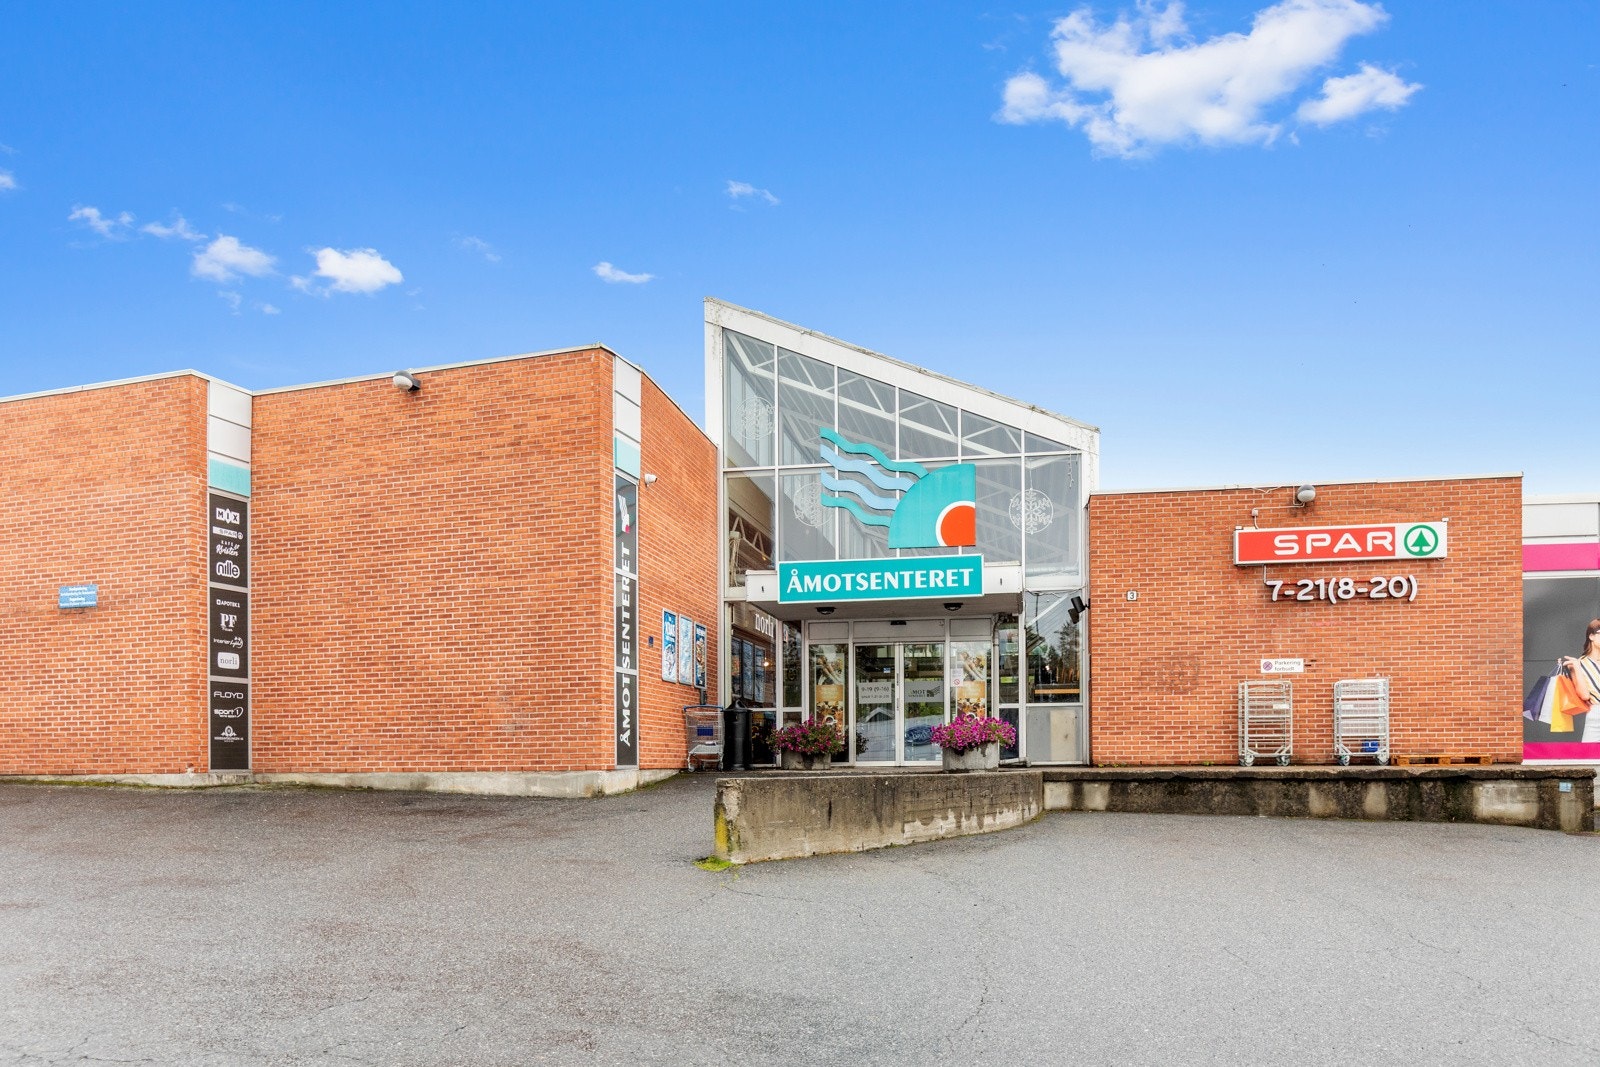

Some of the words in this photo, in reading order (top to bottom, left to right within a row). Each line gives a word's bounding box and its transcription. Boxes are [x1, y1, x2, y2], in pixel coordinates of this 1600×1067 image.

[216, 508, 240, 524] MIX
[1274, 531, 1393, 556] SPAR
[216, 560, 240, 578] nille
[787, 568, 974, 593] ÅMOTSENTERET
[1265, 574, 1418, 604] 7-21(8-20)
[1129, 592, 1135, 600] 3
[220, 613, 237, 628] PF
[620, 542, 630, 747] ÅMOTSENTERET
[220, 657, 238, 665] norli
[213, 691, 244, 699] FLOYD
